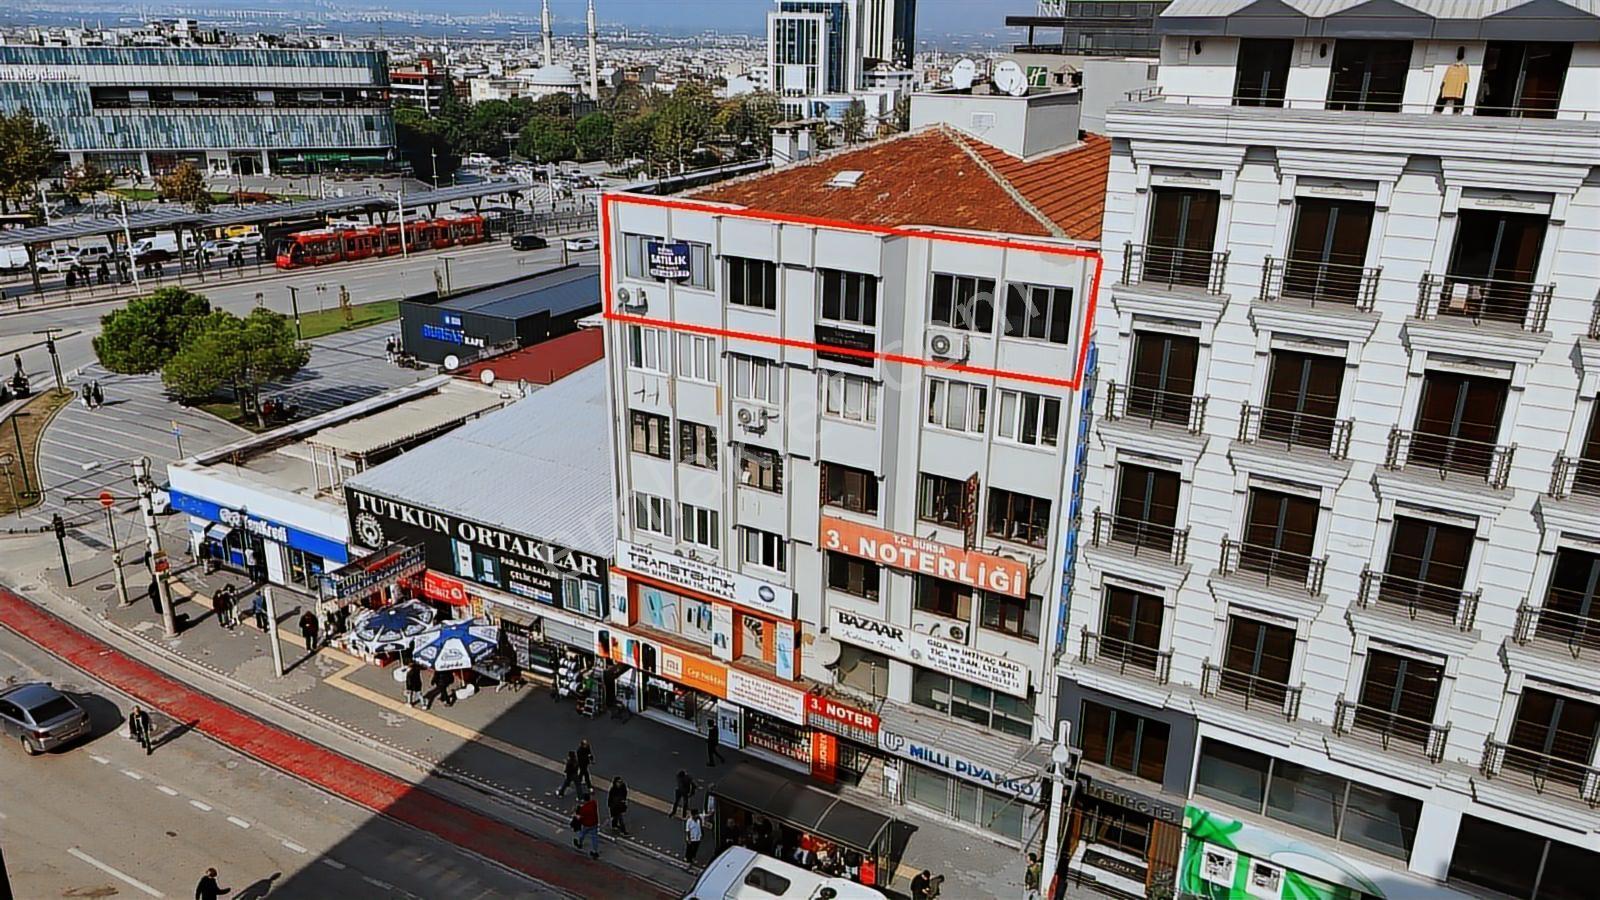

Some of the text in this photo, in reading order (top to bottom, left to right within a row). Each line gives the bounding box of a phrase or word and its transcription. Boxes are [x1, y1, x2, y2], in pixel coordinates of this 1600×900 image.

[353, 491, 450, 535] TUTKUN
[458, 522, 600, 578] ORTAKLAR
[894, 535, 946, 556] T.C. BURSA
[826, 529, 1022, 595] 3. NOTERLİĞİ
[838, 612, 904, 642] BAZAAR
[927, 638, 948, 651] GIDA
[998, 660, 1021, 673] MAD.
[811, 698, 822, 711] 3.
[826, 703, 873, 728] NOTER
